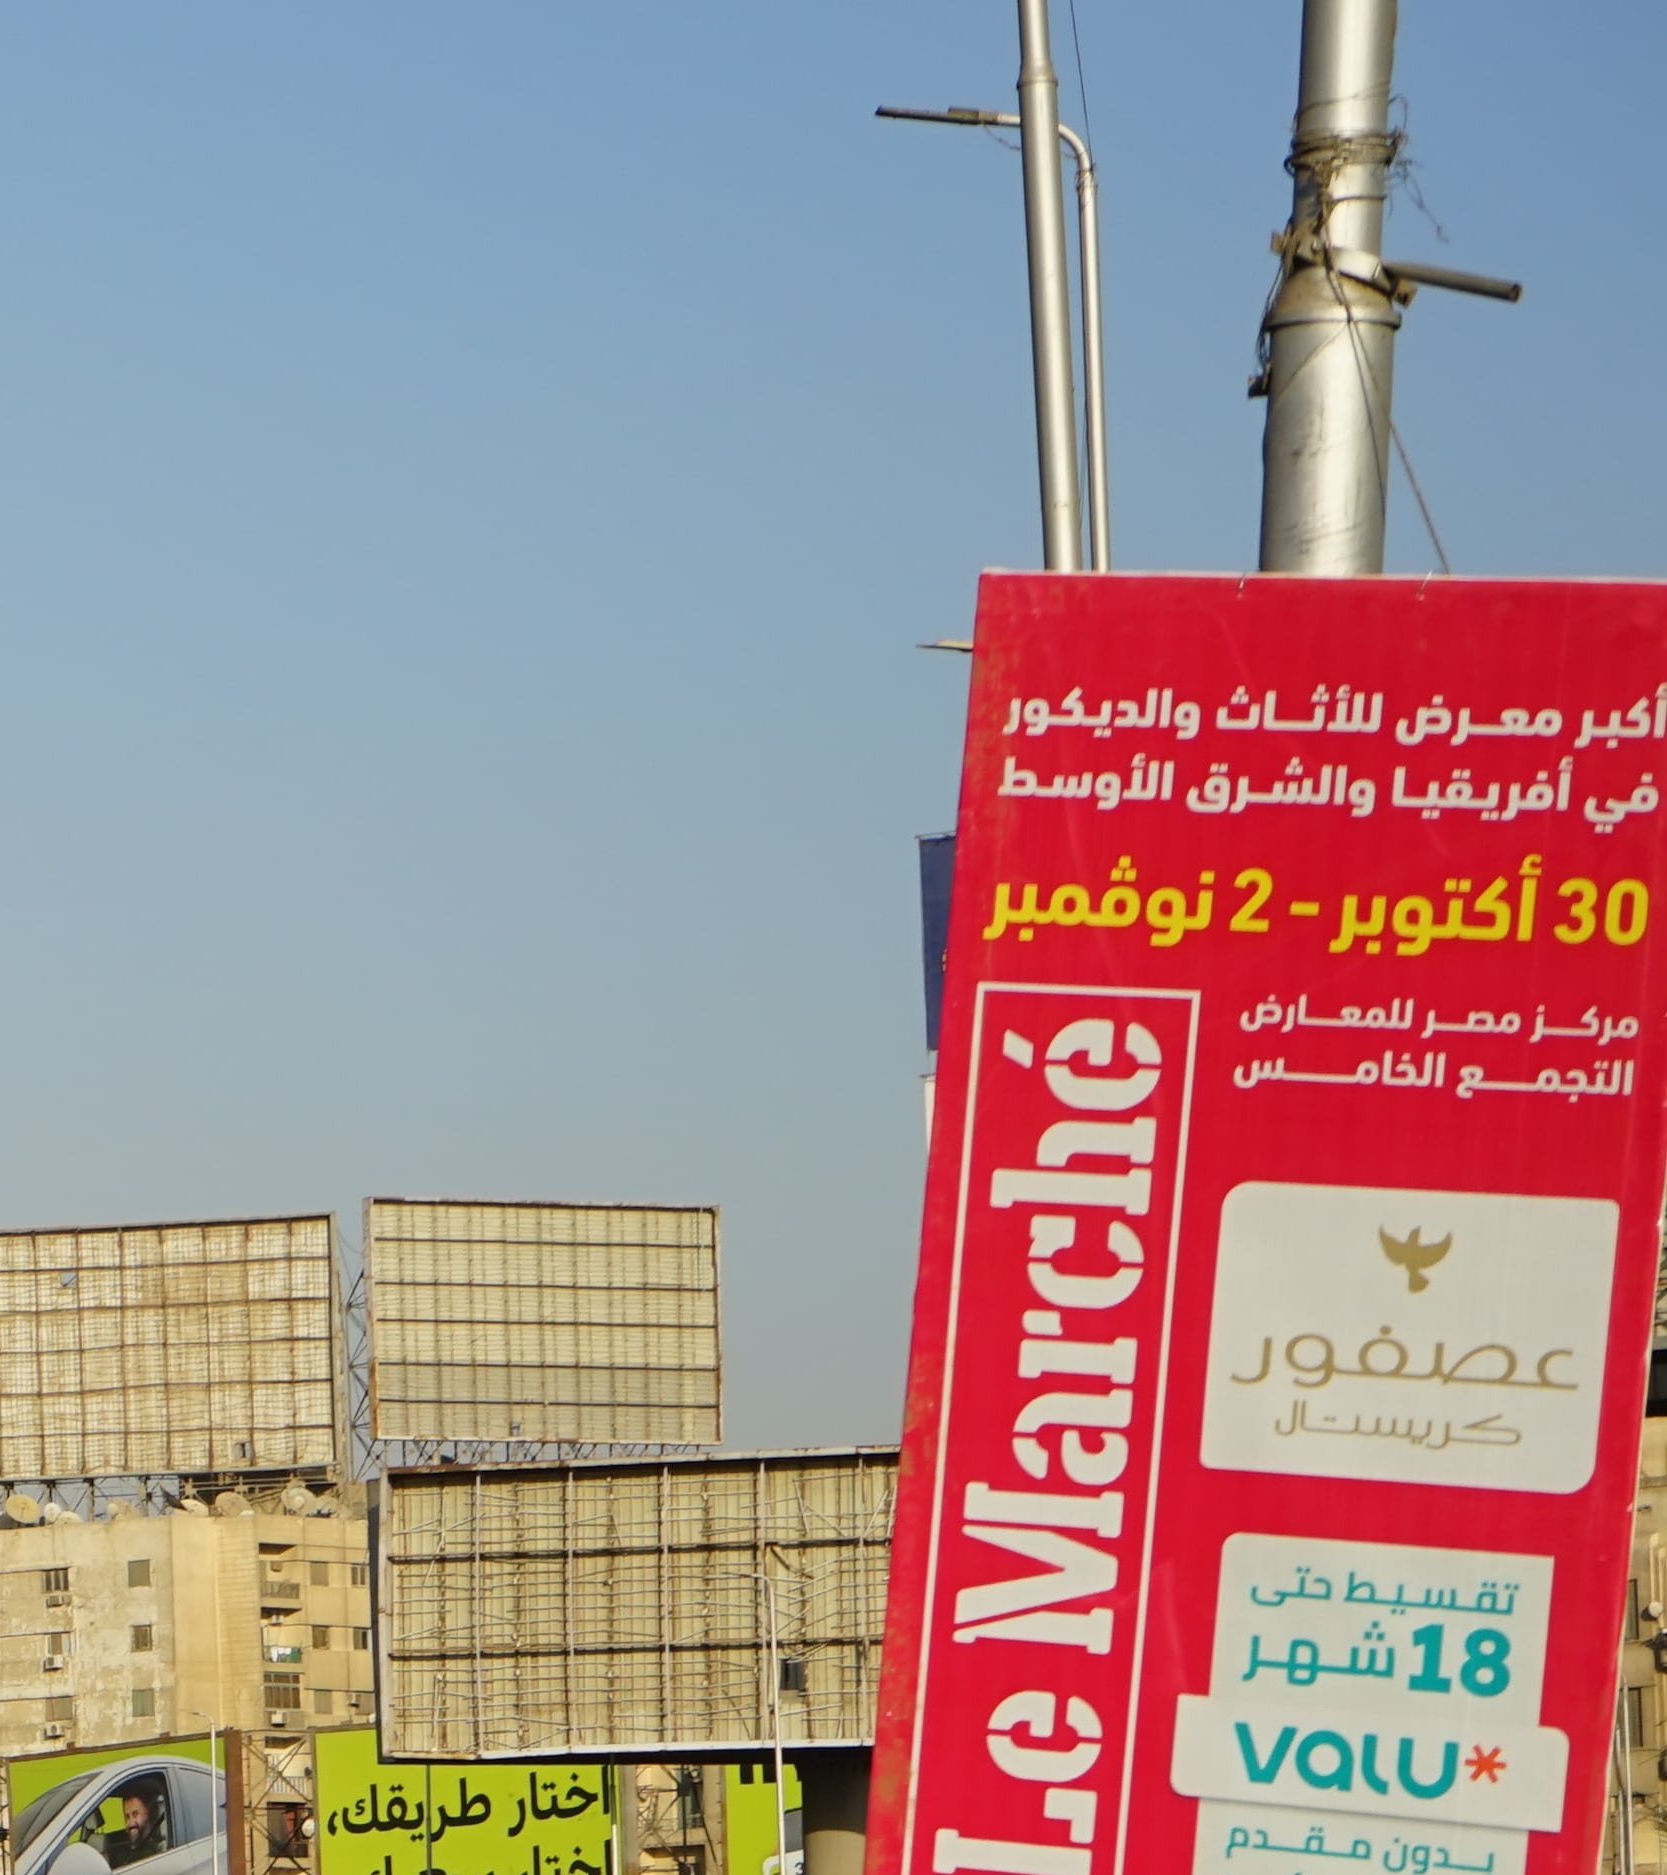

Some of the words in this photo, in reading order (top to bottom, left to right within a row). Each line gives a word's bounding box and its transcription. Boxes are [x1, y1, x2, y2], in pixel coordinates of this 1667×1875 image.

[1003, 687, 1200, 739] والديكور
[1217, 685, 1383, 732] للأثاث
[1396, 696, 1562, 745] معرض
[1575, 683, 1667, 748] أكبر
[998, 753, 1174, 809] الأوسط
[1187, 758, 1375, 816] والشرق
[1393, 757, 1572, 820] أفريقيا
[1585, 774, 1658, 832] في
[1231, 869, 1272, 931] 2
[1330, 855, 1541, 955] أكتوبر
[1555, 879, 1648, 944] 30
[1241, 995, 1413, 1032] للمعارض
[1422, 1011, 1520, 1038] مصر
[1530, 1006, 1638, 1045] مركز
[1234, 1051, 1445, 1088] الخامس
[1457, 1060, 1634, 1102] التجمع
[952, 1017, 1163, 1656] Marché
[1230, 1325, 1578, 1391] عصفور
[1275, 1400, 1521, 1450] كريستال
[1250, 1567, 1332, 1607] حتى
[1344, 1571, 1519, 1622] تقسيط
[1242, 1621, 1395, 1686] شهر
[1408, 1624, 1511, 1698] 18
[507, 1763, 611, 1838] اختار
[1226, 1827, 1371, 1860] مقدم
